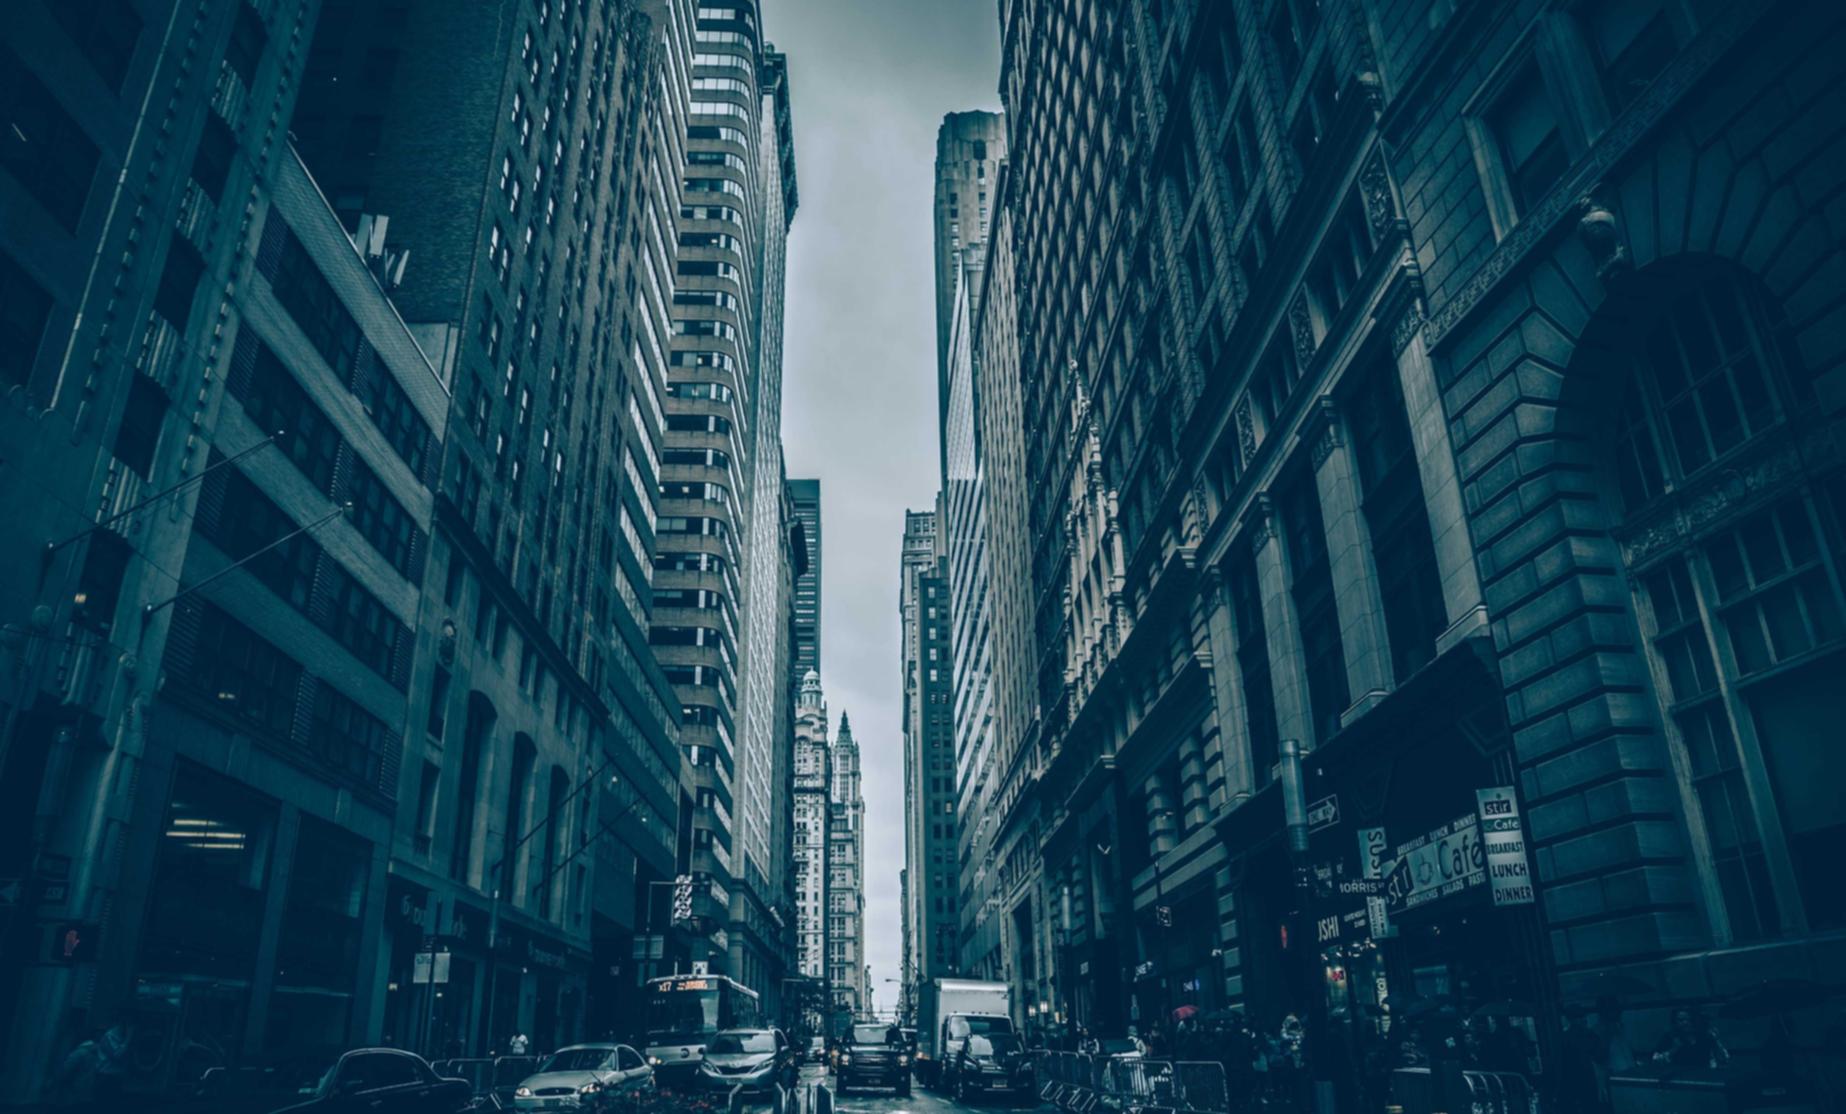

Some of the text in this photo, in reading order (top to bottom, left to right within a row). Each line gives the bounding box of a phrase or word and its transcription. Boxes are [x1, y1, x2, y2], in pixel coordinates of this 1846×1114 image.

[1486, 799, 1509, 814] stir
[1485, 841, 1524, 856] BREAKFAST
[1491, 863, 1528, 878] LUNCH
[1494, 885, 1533, 904] DINNER
